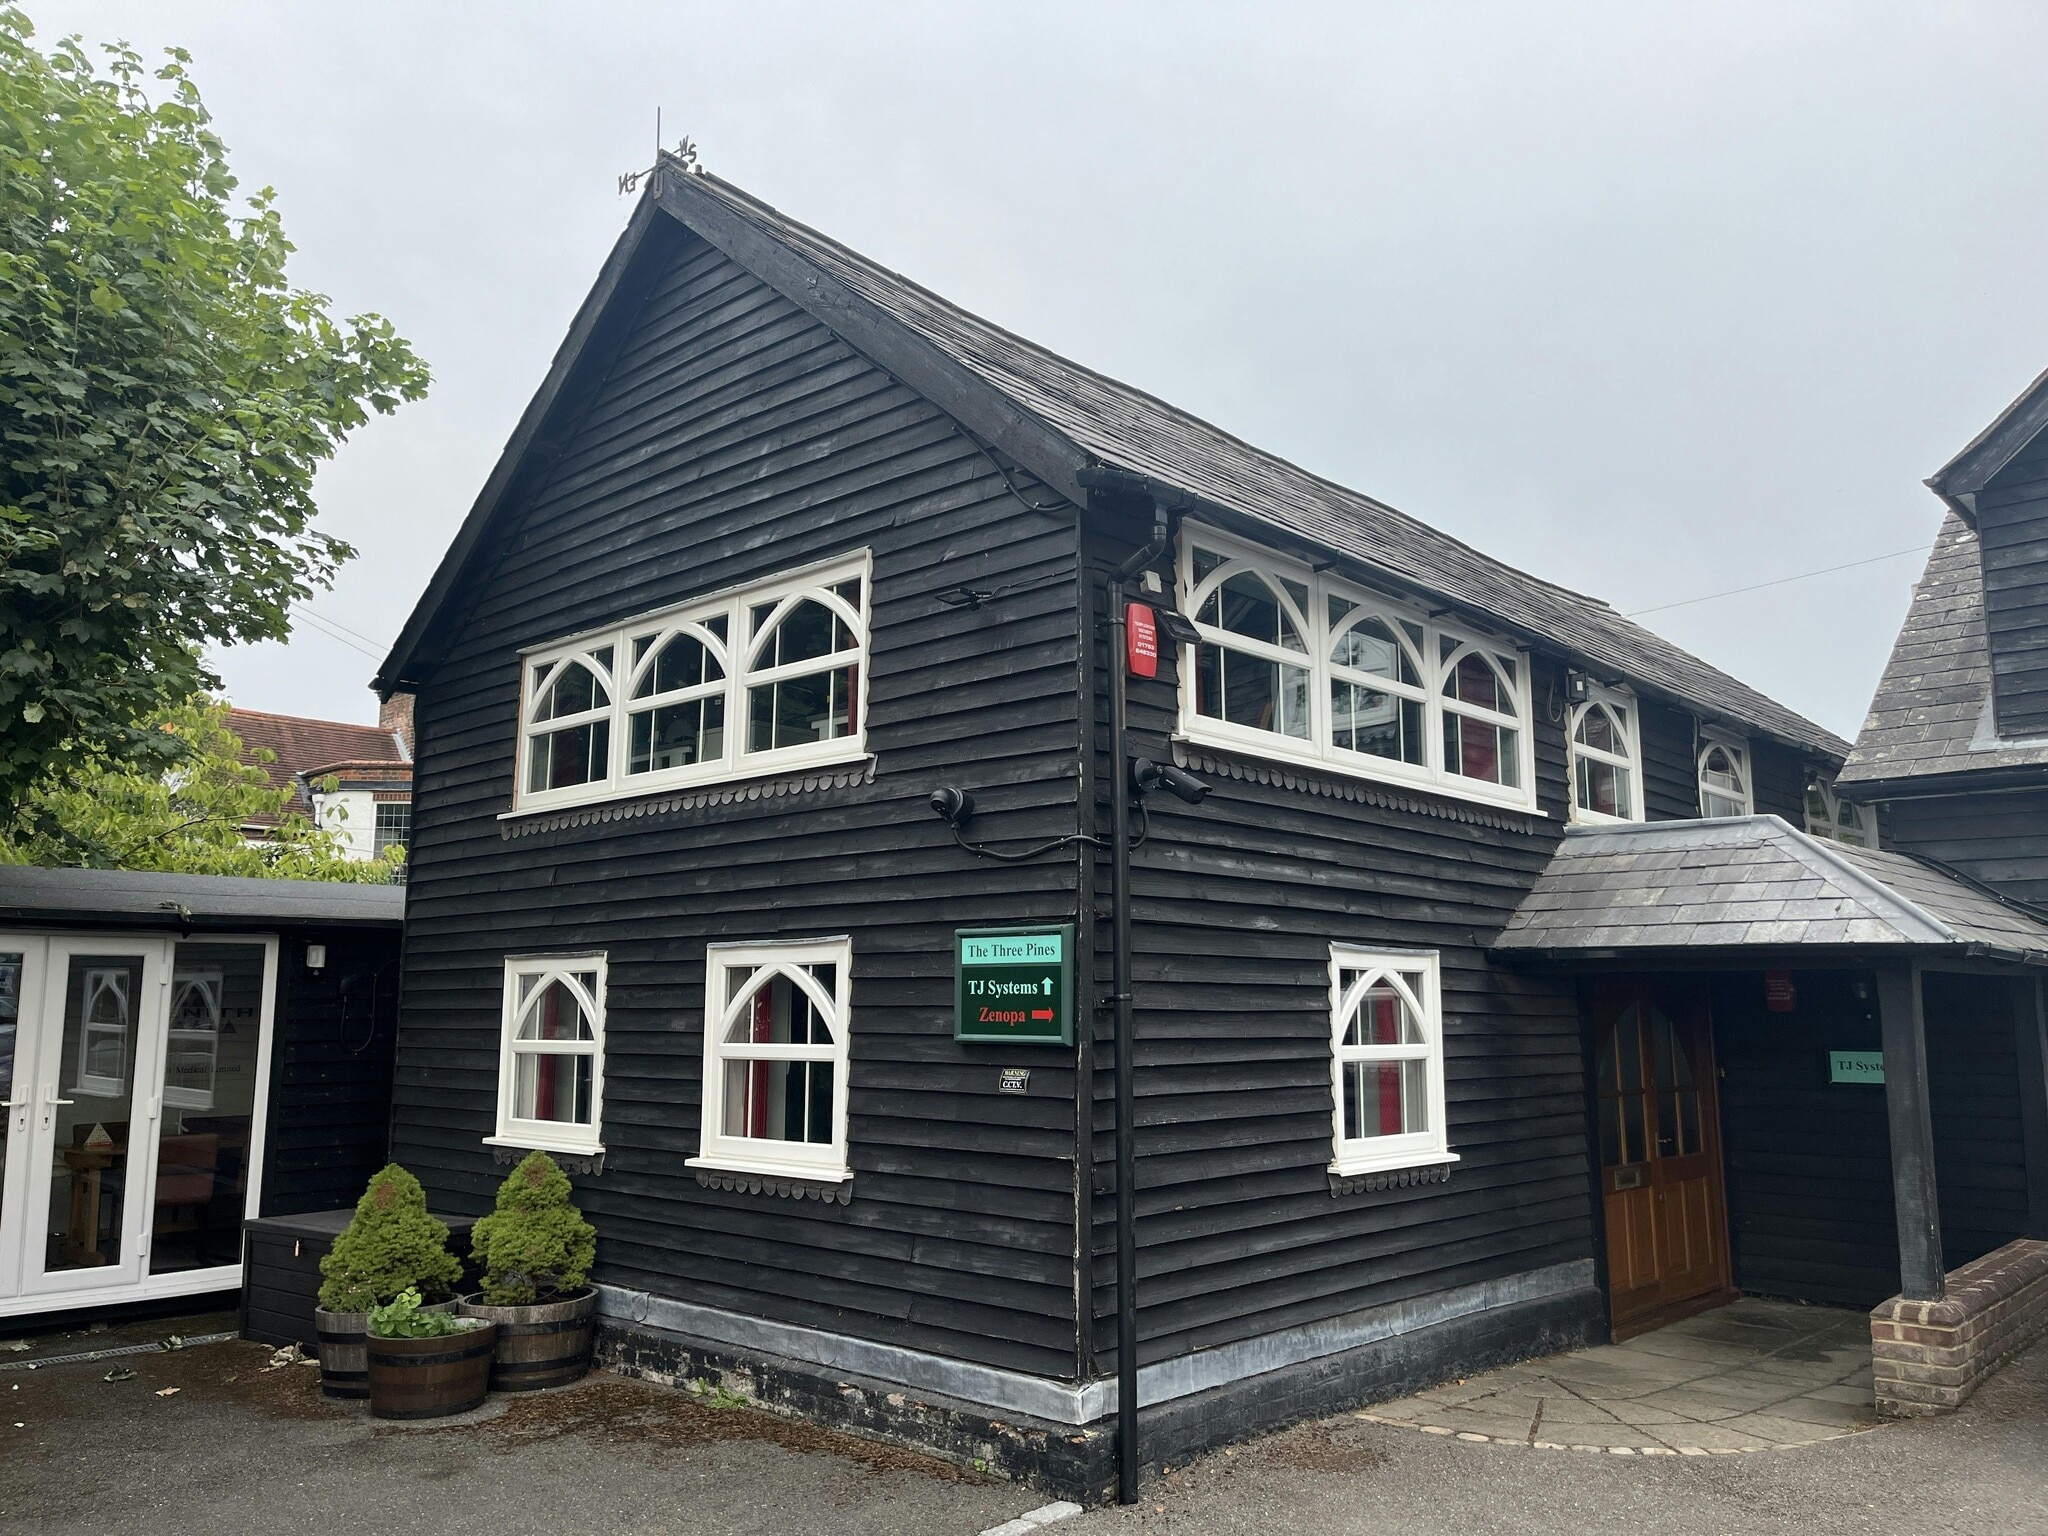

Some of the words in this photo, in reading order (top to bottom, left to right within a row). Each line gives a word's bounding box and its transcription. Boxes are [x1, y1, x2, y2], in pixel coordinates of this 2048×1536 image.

[968, 944, 988, 957] The
[991, 944, 1023, 957] Three
[1026, 942, 1055, 956] Pines
[968, 980, 984, 994] TJ
[988, 980, 1038, 998] Systems
[980, 1007, 1026, 1026] Zenopa
[1837, 1060, 1852, 1070] TJ
[1856, 1061, 1885, 1073] Syste
